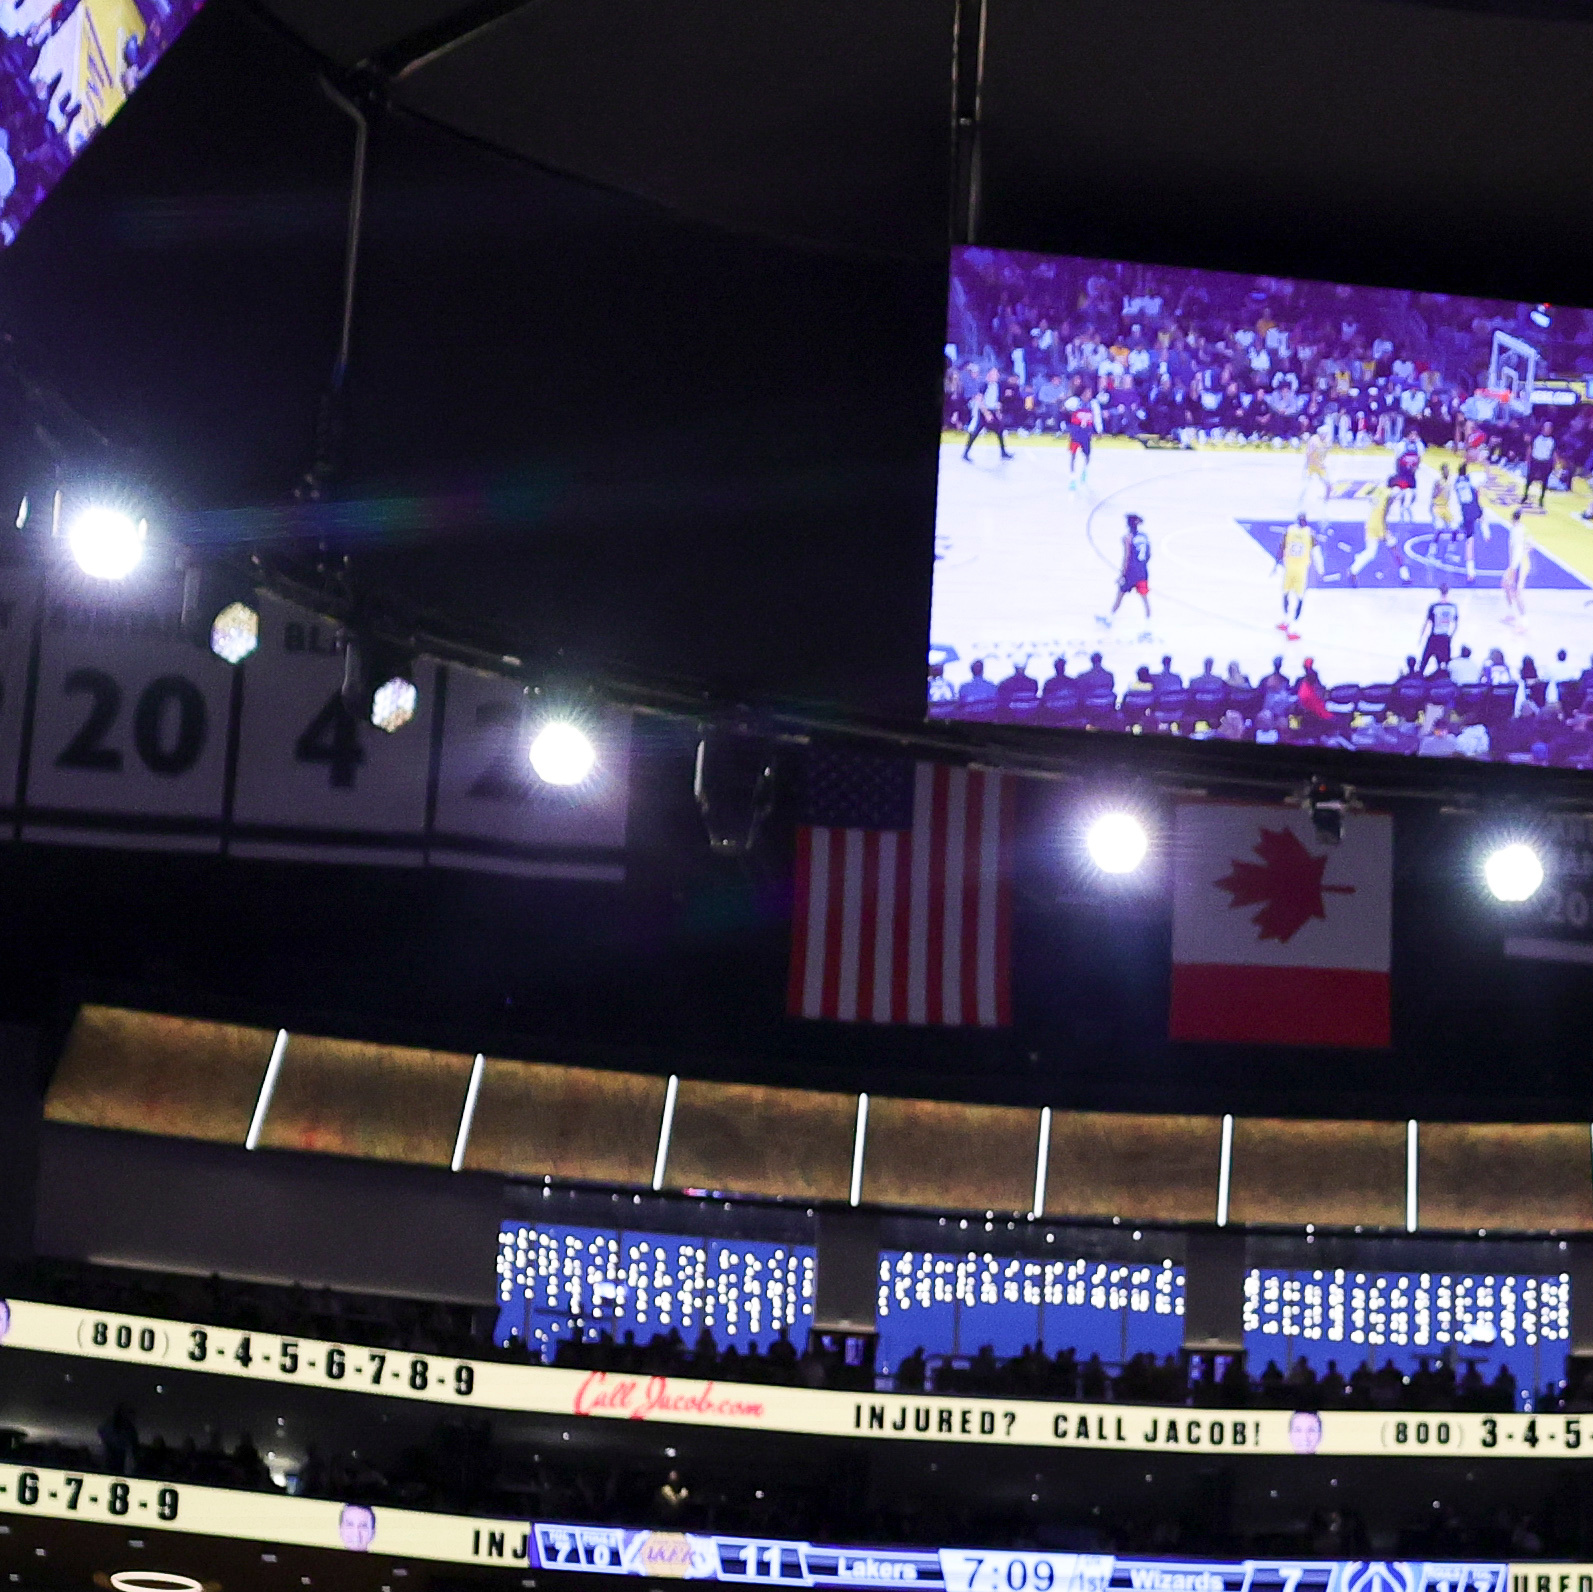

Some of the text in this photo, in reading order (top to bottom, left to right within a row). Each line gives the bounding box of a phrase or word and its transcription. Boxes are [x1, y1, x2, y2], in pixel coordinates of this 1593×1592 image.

[55, 667, 208, 777] 20
[295, 690, 364, 789] 4
[573, 1370, 636, 1416] Call
[854, 1403, 1261, 1447] INJURED? CALL JACOB!
[739, 1545, 781, 1578] 11
[837, 1554, 919, 1581] Lakers
[963, 1557, 1055, 1592] 7:09
[1130, 1568, 1225, 1592] Wizards
